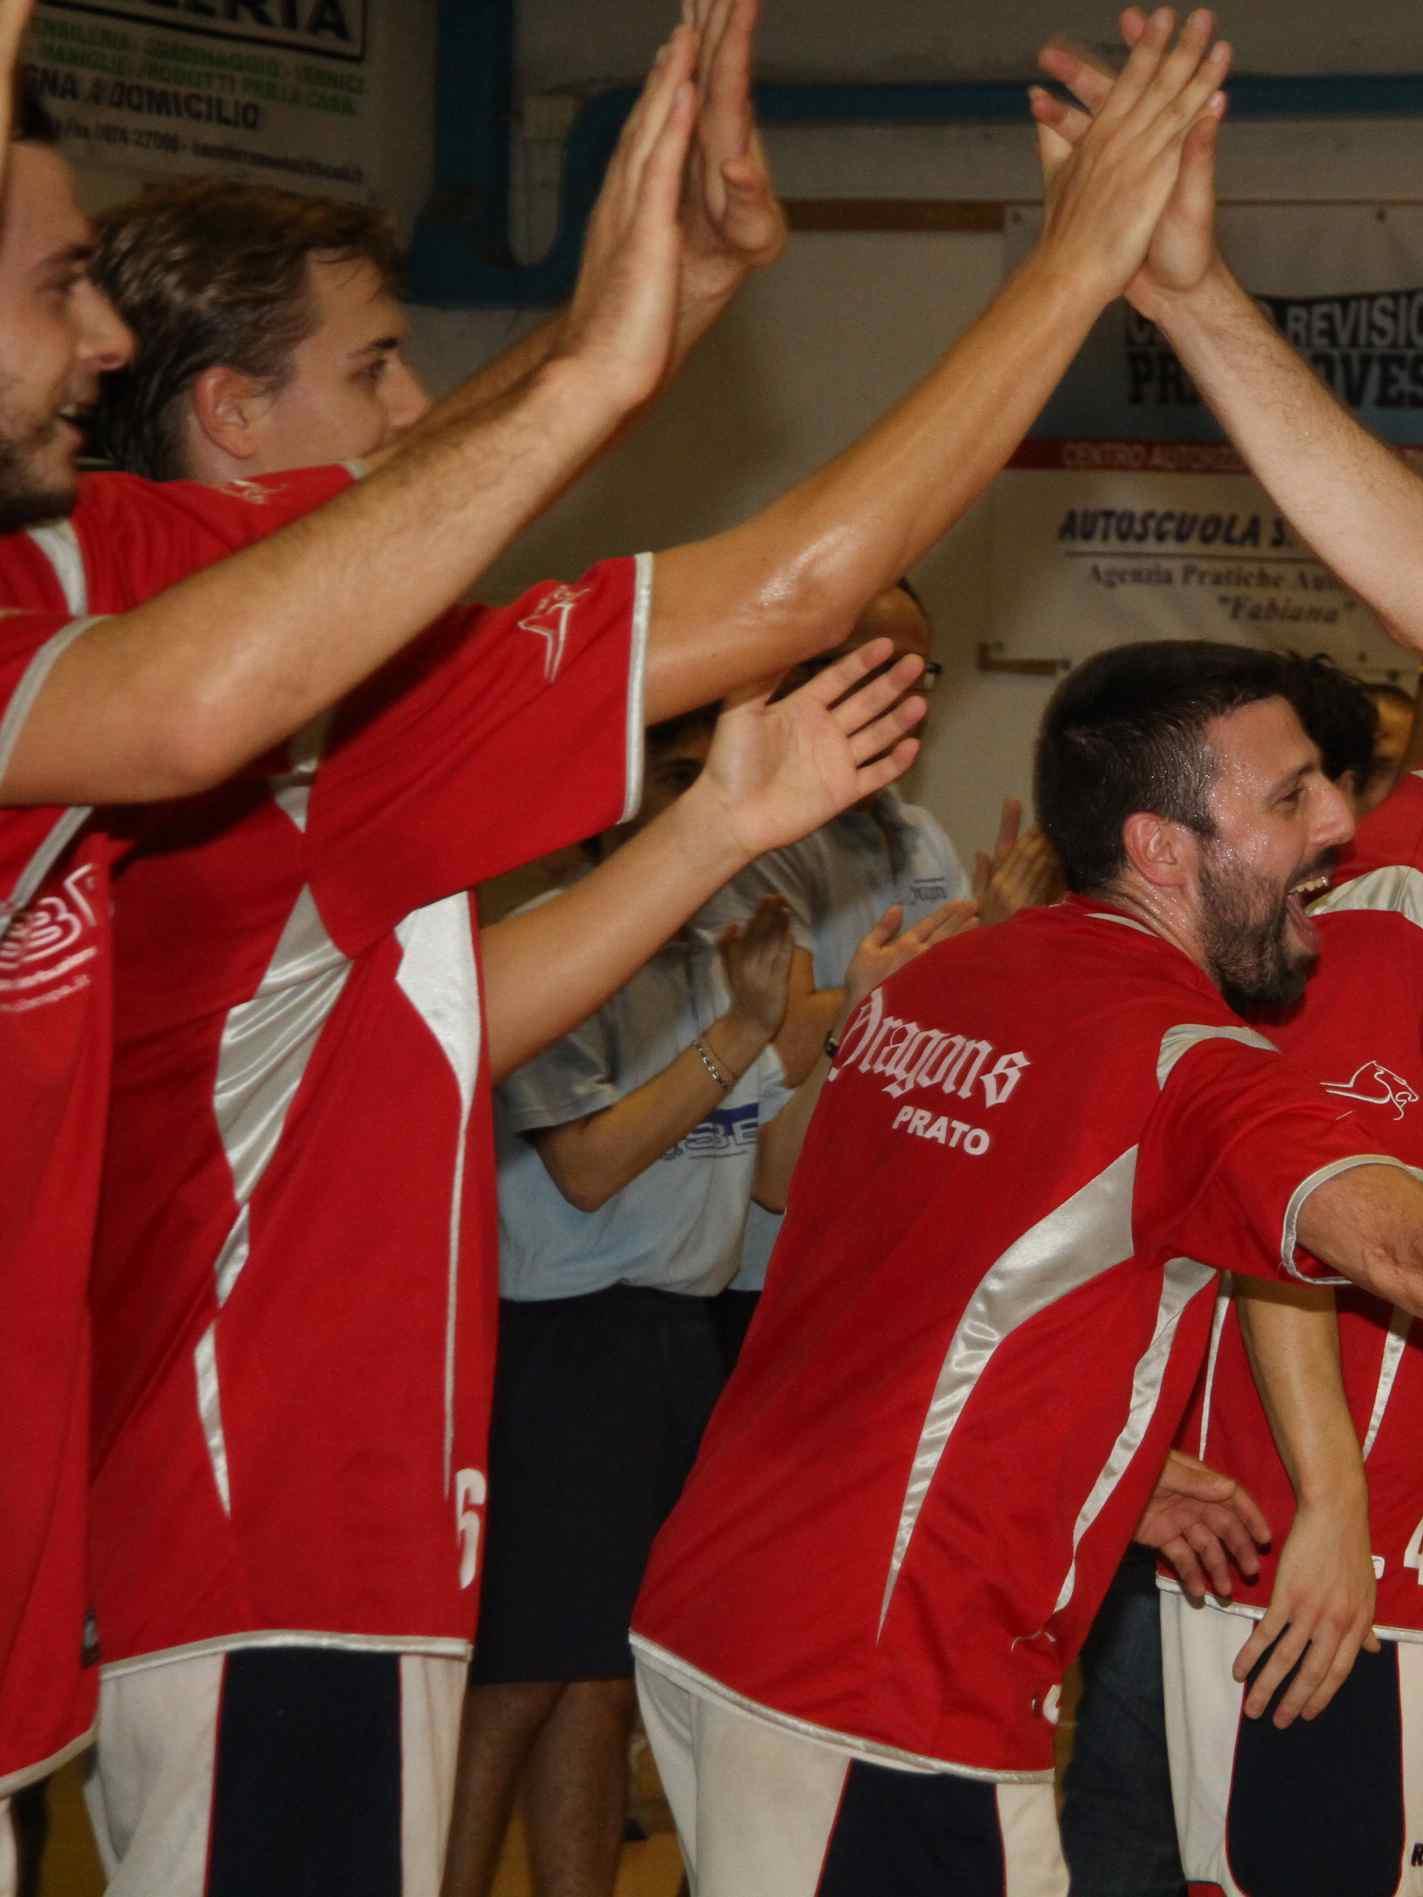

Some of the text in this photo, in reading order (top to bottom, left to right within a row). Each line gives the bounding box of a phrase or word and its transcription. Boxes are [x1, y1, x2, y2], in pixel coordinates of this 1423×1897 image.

[109, 80, 261, 130] DOMICILIO
[1058, 508, 1262, 549] AUTOSCUOLA
[1089, 564, 1174, 588] Agenzia
[1181, 564, 1282, 591] Pratiche
[891, 1105, 991, 1157] PRATO
